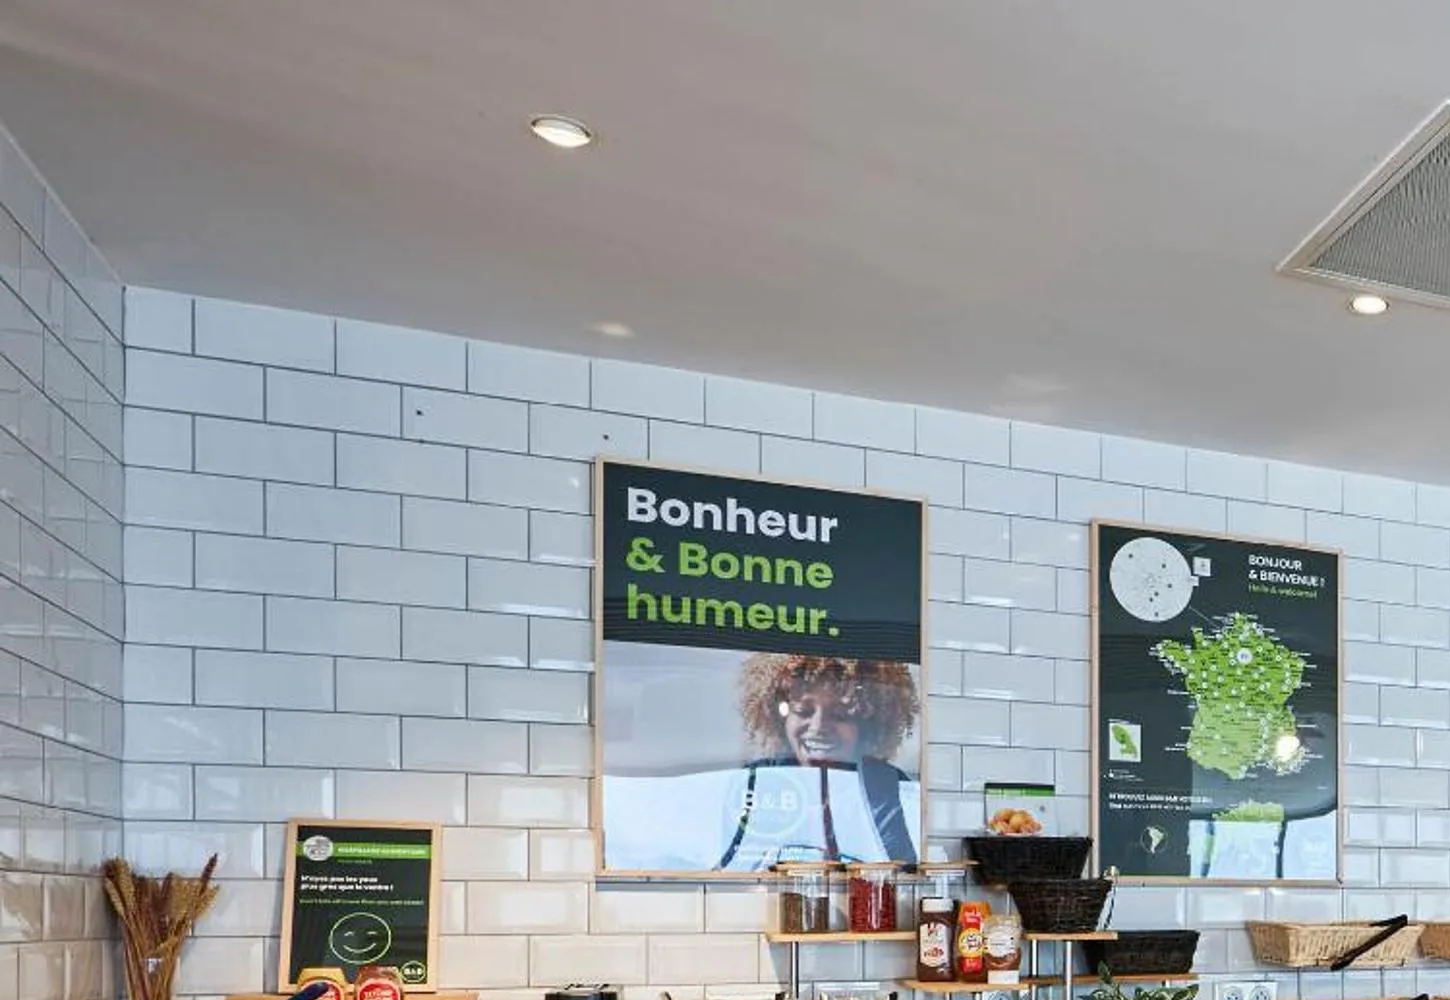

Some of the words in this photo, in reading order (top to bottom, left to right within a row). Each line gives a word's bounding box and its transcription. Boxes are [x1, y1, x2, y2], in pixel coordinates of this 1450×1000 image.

[627, 486, 838, 543] Bonheur
[626, 536, 666, 573] &
[679, 541, 834, 589] Bonne
[1248, 554, 1303, 571] BONJOUR
[1248, 569, 1258, 579] &
[1260, 570, 1319, 587] BIENVENUE
[627, 583, 840, 637] humeur.
